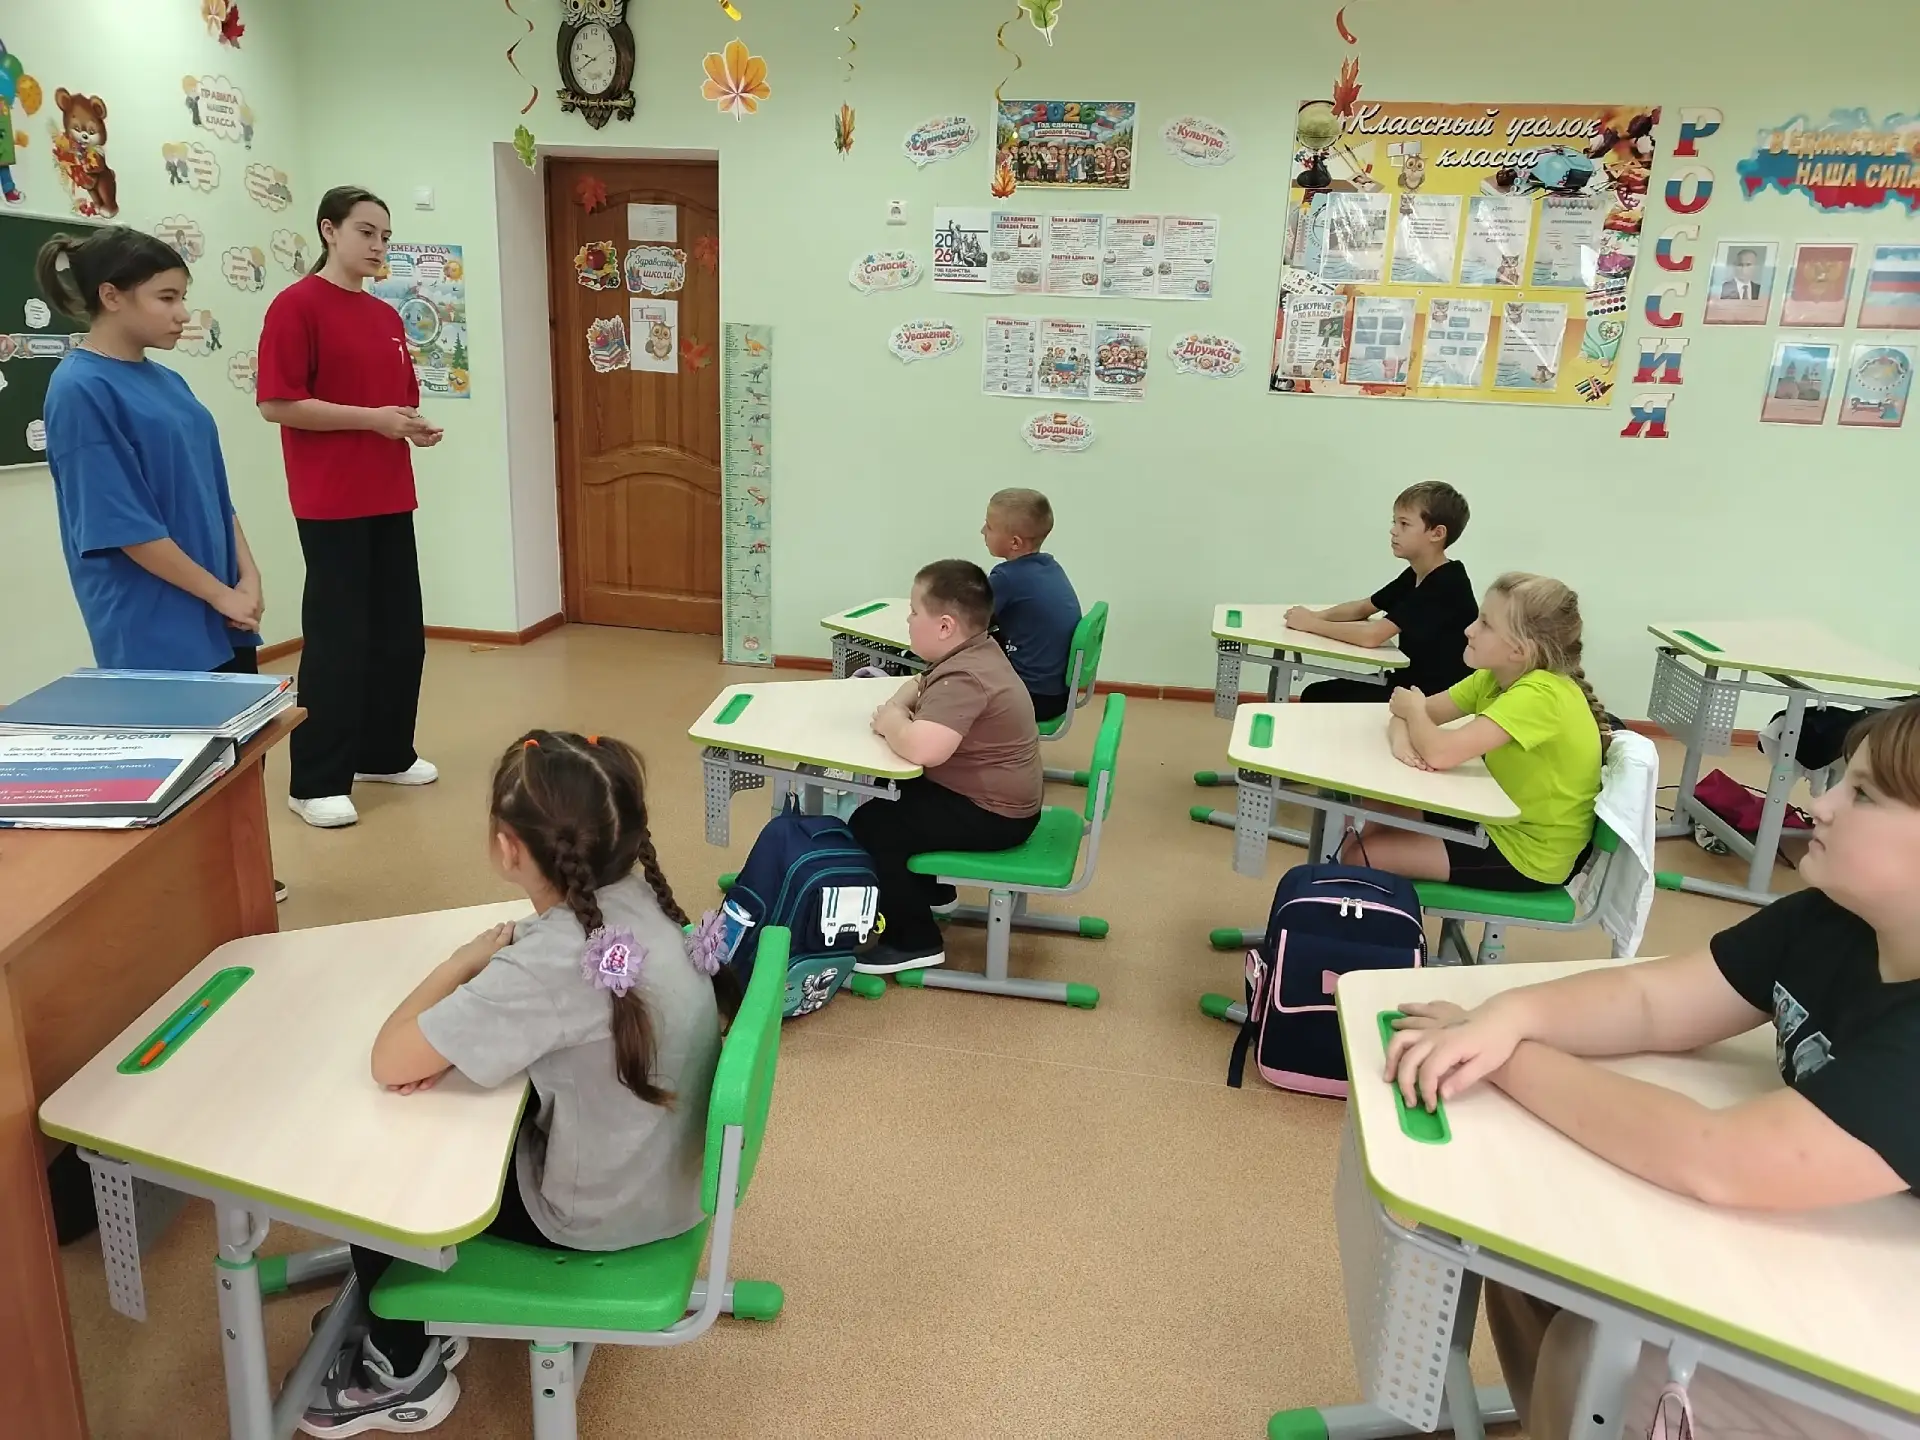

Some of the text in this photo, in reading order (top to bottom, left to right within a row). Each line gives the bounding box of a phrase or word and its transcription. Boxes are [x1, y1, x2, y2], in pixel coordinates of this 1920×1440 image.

[603, 33, 606, 41] 1
[608, 44, 613, 52] 2
[583, 78, 588, 86] 7
[201, 88, 239, 105] ПРАВИЛА
[206, 103, 234, 115] НАШЕГО
[1031, 102, 1097, 124] 2026
[205, 116, 236, 128] КЛАССА
[1037, 121, 1088, 130] Год единства
[1348, 103, 1605, 146] Классный уголок
[910, 126, 966, 152] Единство
[1176, 124, 1224, 149] Культура
[1768, 130, 1900, 159] В ЕДИНСТВЕ
[1434, 147, 1541, 169] класса
[1795, 161, 1920, 189] НАША СИЛА
[935, 233, 953, 248] 20
[386, 243, 451, 254] РЕМЕНА ГОДА
[934, 248, 953, 263] 26
[864, 260, 908, 275] Согласие
[642, 270, 676, 280] школа!
[1293, 302, 1332, 313] ДЕЖУРНЫЕ
[1307, 310, 1332, 318] КЛАССУ
[903, 330, 951, 344] Уважение
[1183, 341, 1232, 361] Дружба
[1035, 423, 1084, 436] Традиции
